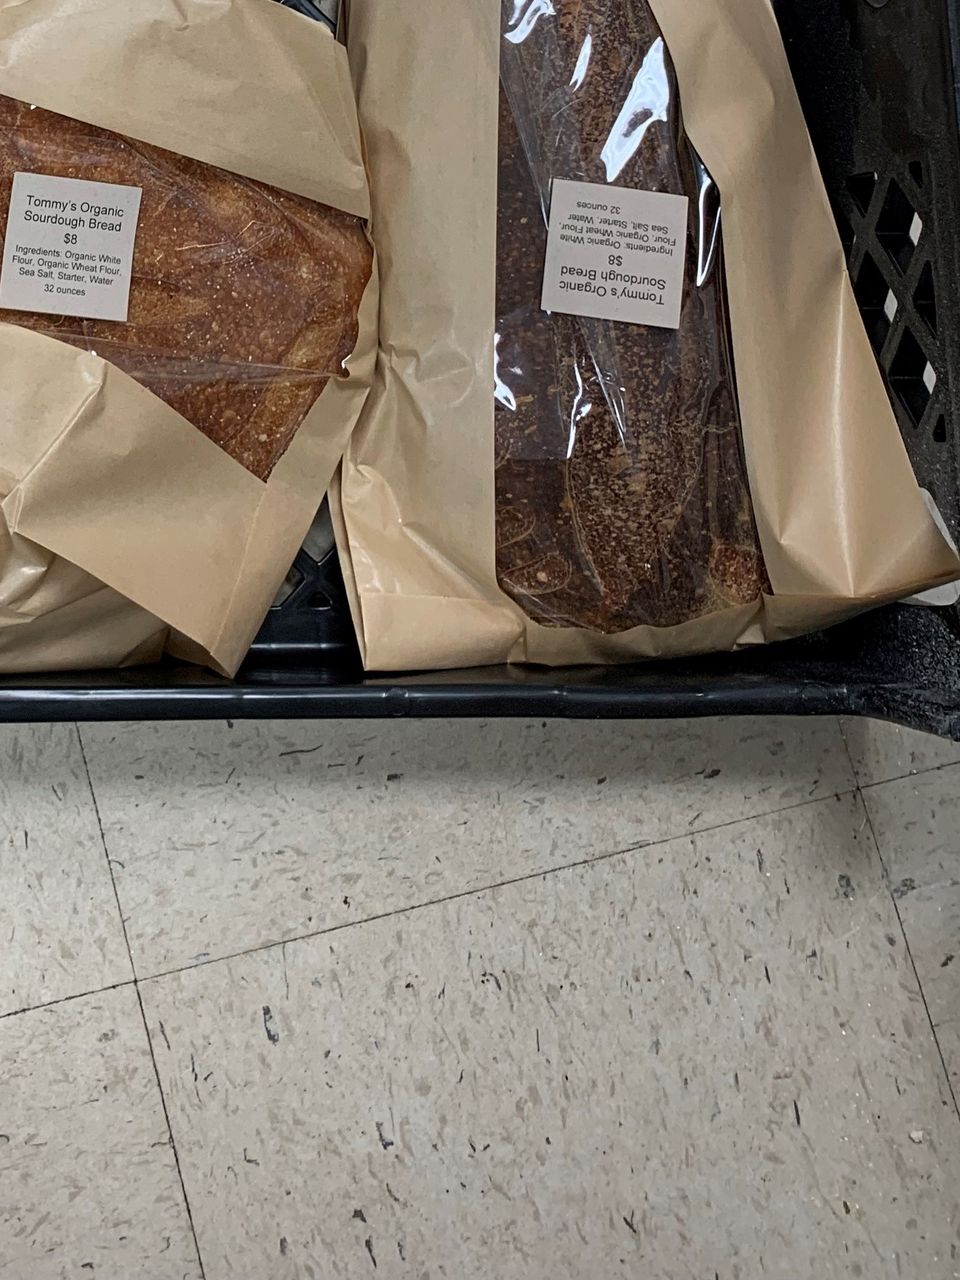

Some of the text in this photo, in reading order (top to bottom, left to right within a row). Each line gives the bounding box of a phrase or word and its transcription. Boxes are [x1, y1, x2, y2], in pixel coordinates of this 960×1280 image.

[27, 195, 124, 217] Tommy's Organic
[577, 202, 620, 214] 32 ounces
[24, 210, 121, 232] Sourdough Bread
[568, 214, 594, 224] Water
[586, 227, 613, 237] Wheat
[651, 225, 669, 234] Sea
[64, 233, 77, 244] $8
[560, 234, 585, 245] White
[616, 230, 649, 242] Organic
[587, 238, 620, 249] Organic
[65, 250, 96, 262] Organic
[99, 255, 121, 264] White
[608, 254, 623, 266] $8
[37, 258, 69, 269] Organic
[71, 262, 97, 273] Wheat
[19, 267, 34, 276] Sea
[90, 276, 113, 286] Water
[561, 266, 666, 290] Sourdough Bread
[44, 284, 85, 296] 32 ounces
[560, 281, 664, 305] Tommy's Organic
